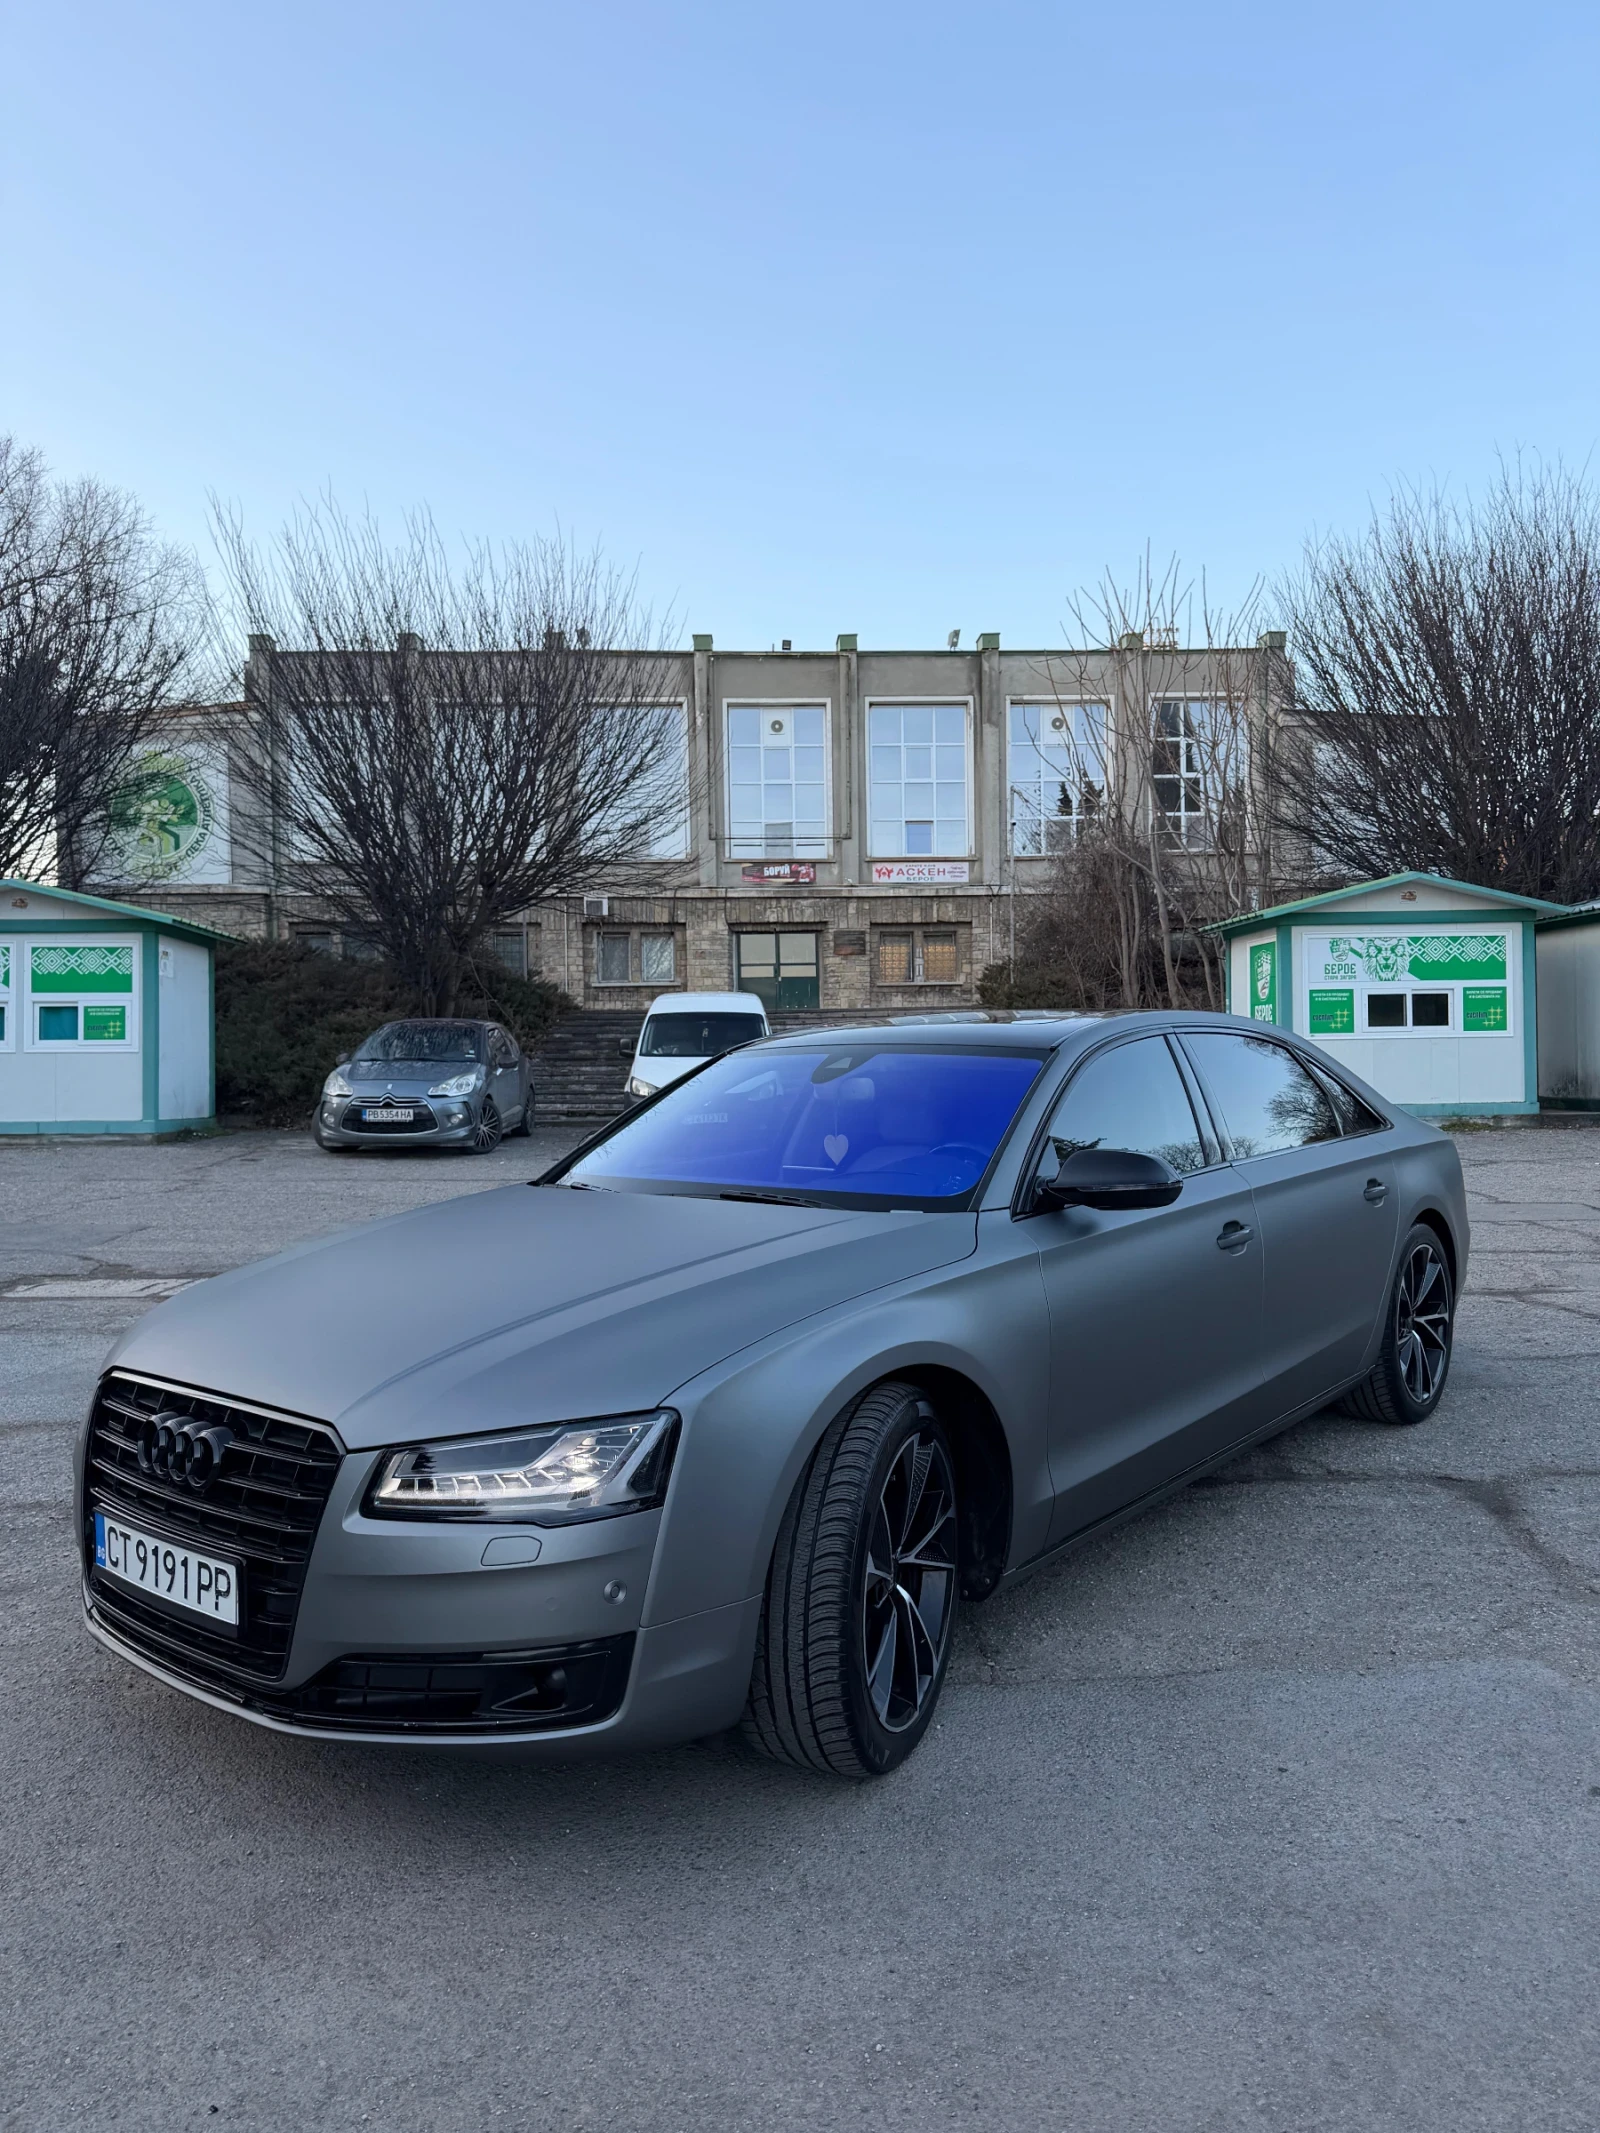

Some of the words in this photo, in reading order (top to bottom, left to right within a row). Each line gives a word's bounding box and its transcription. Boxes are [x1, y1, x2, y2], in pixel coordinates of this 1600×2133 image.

[763, 864, 791, 876] БОРУЙ
[896, 867, 946, 876] АСКЕН
[1324, 963, 1356, 975] БЕРОЕ
[97, 1545, 106, 1560] BG
[107, 1526, 131, 1574] CT
[136, 1539, 189, 1600] 9191
[197, 1560, 232, 1612] PP
